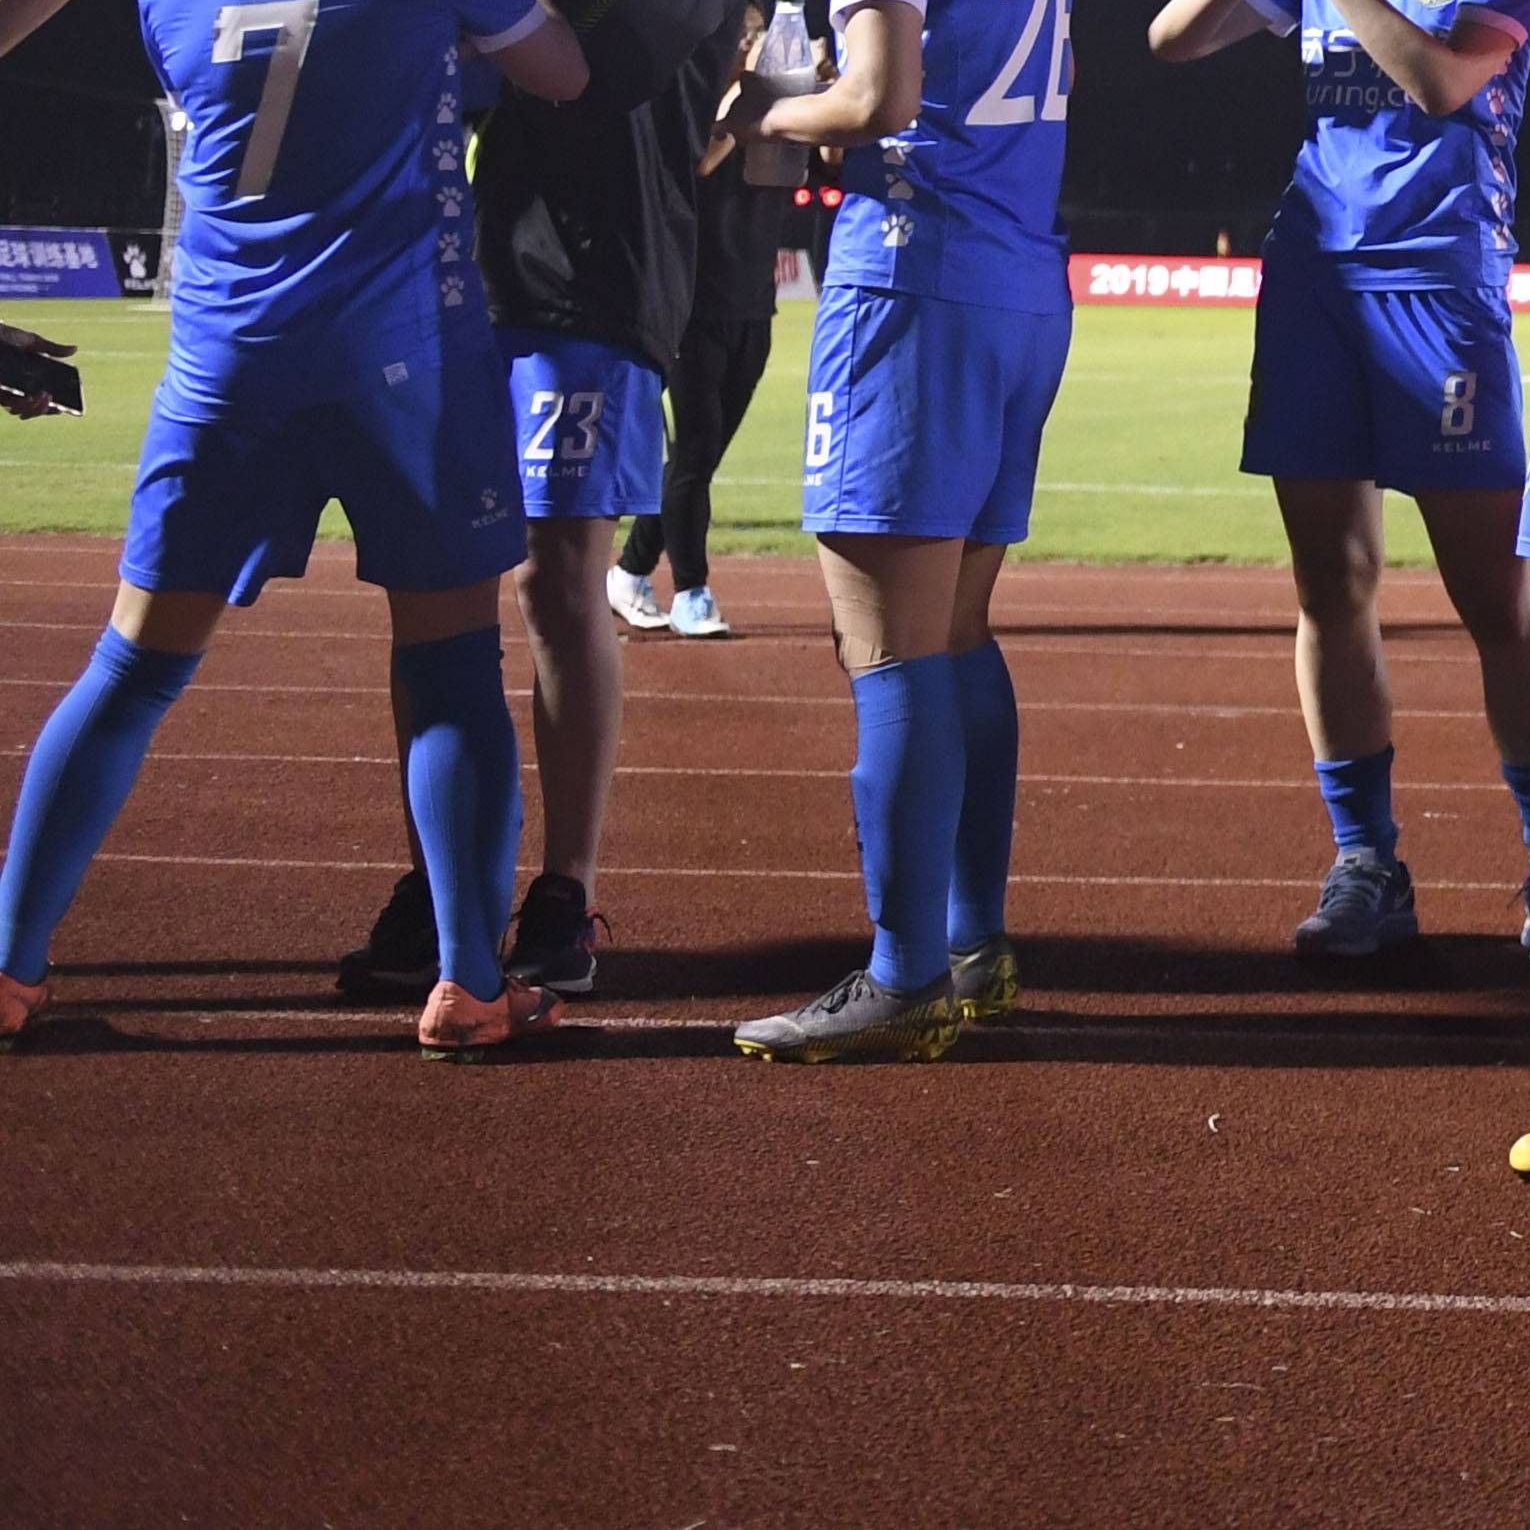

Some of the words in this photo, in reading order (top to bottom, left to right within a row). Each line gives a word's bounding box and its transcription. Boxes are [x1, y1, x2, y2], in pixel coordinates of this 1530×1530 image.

[1441, 370, 1477, 437] 8
[523, 390, 604, 461] 23
[1432, 439, 1492, 454] KELME
[526, 464, 590, 479] KELME
